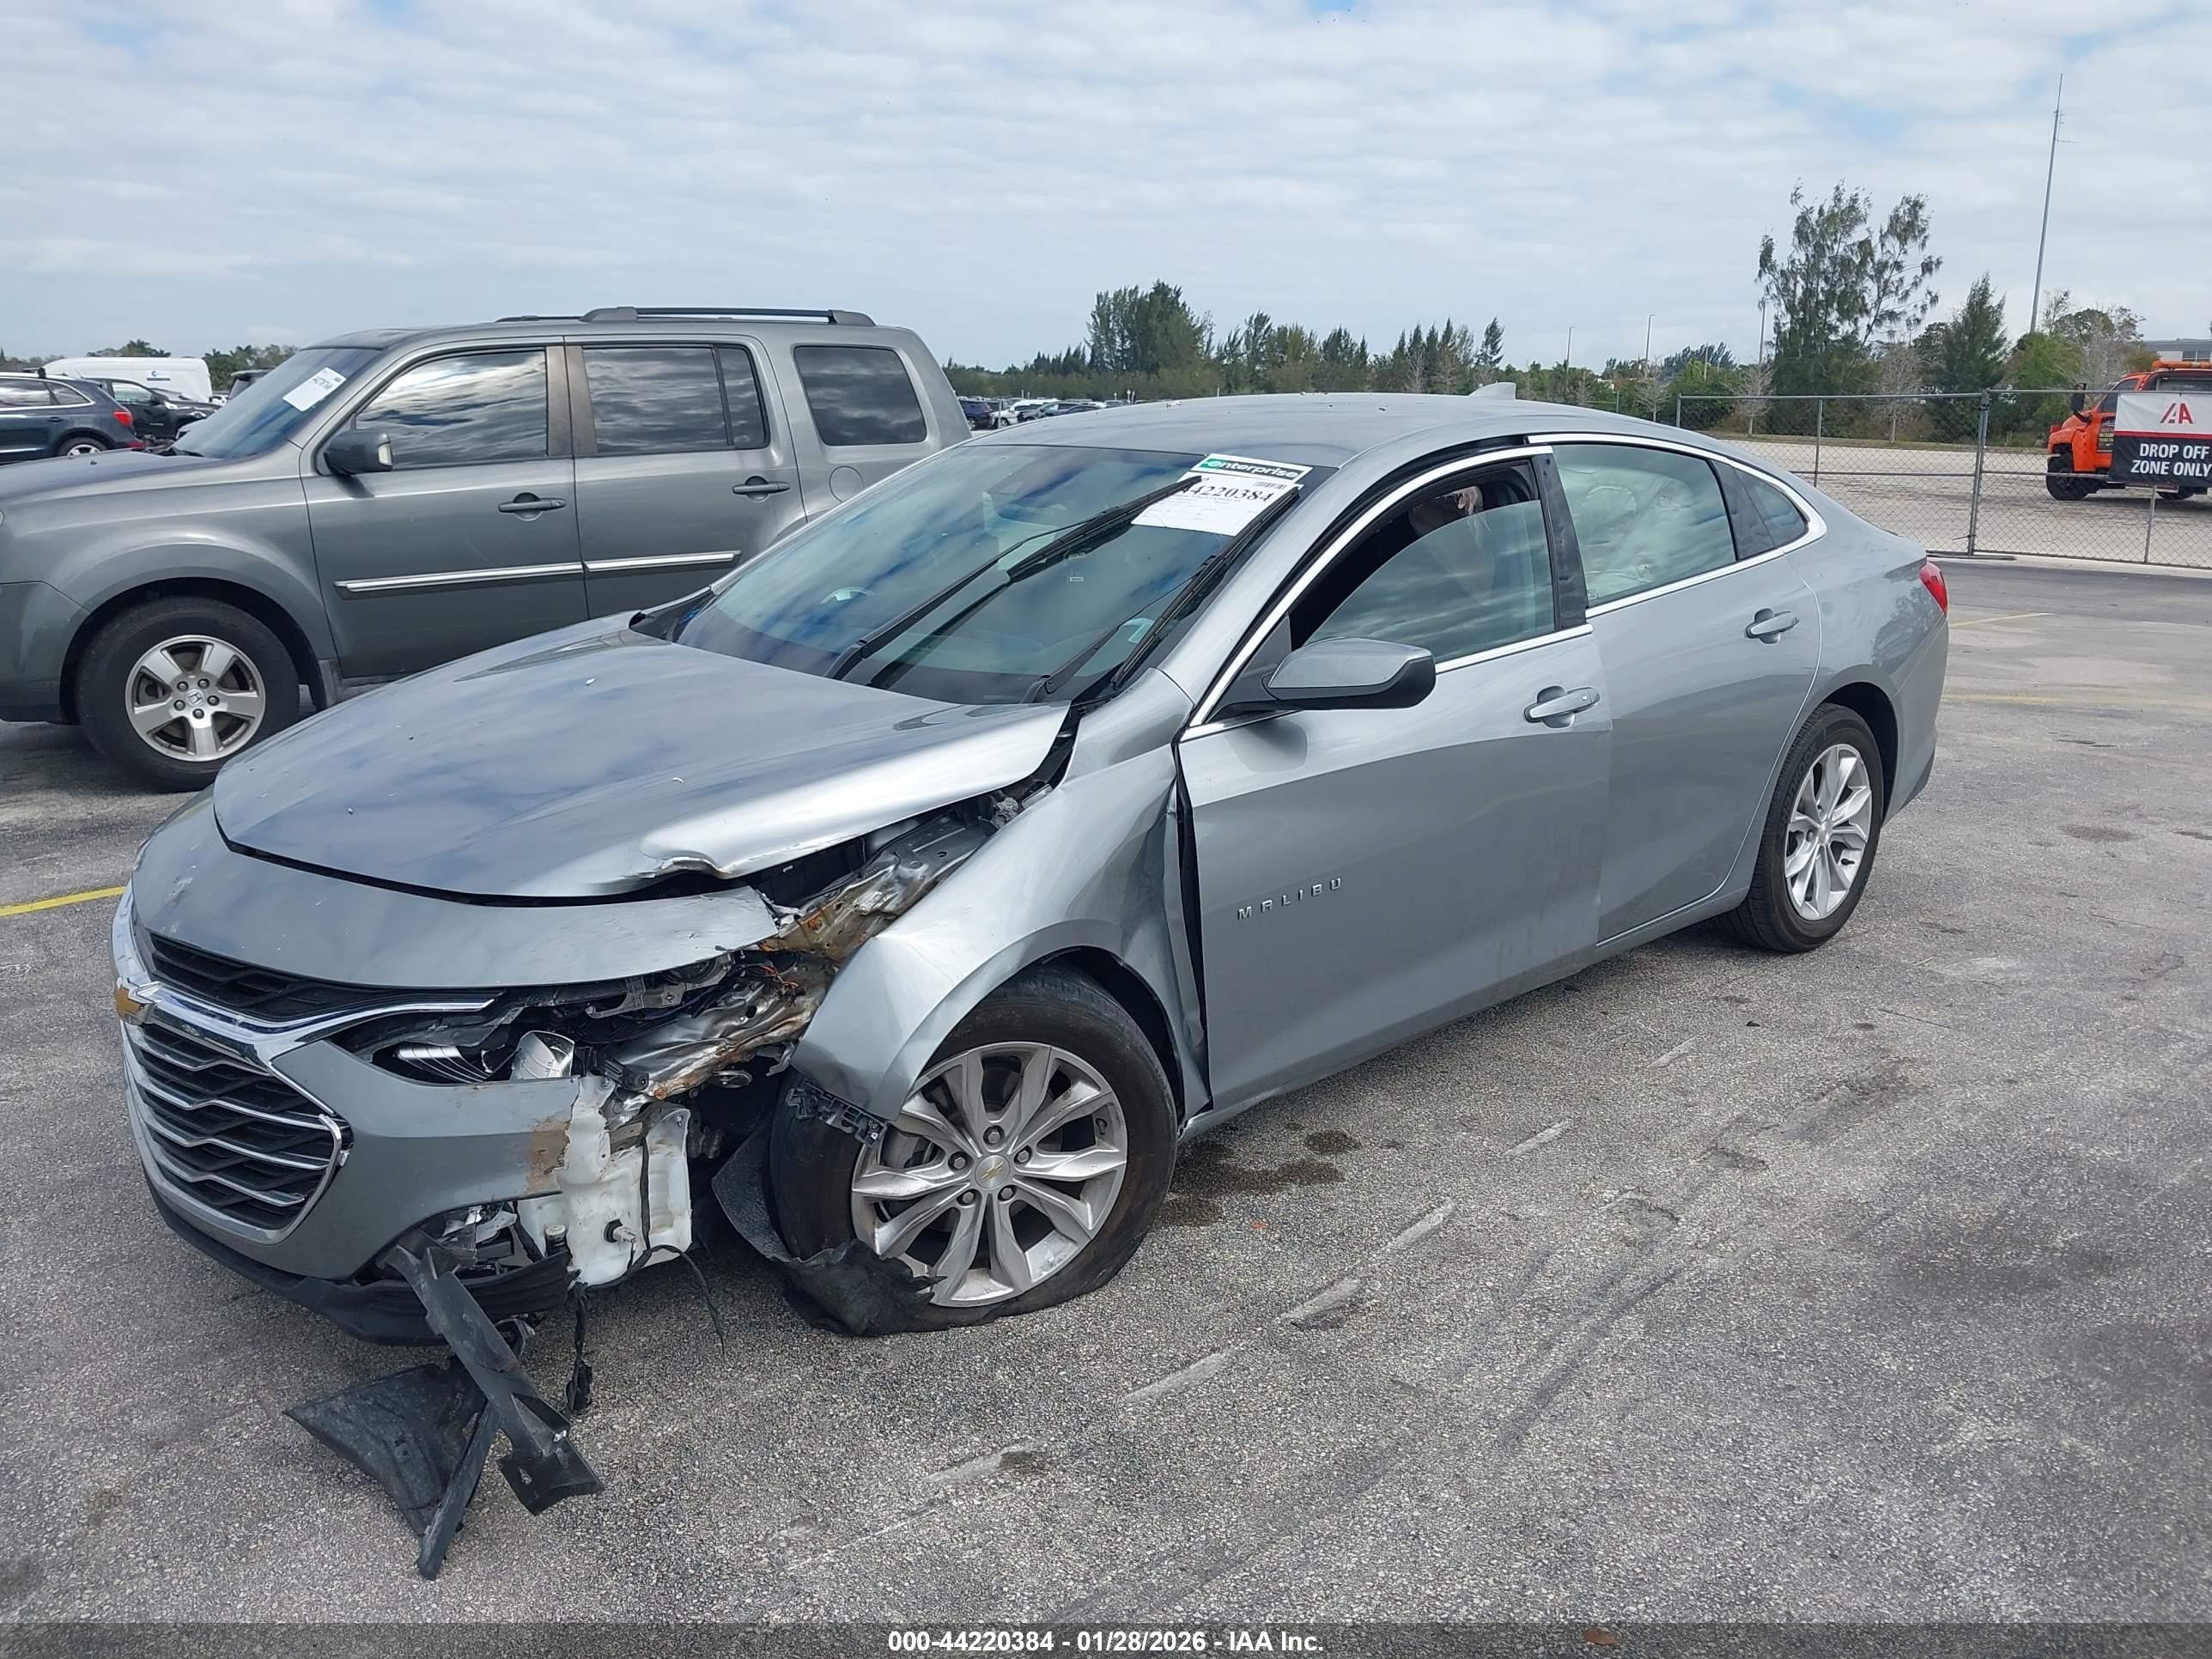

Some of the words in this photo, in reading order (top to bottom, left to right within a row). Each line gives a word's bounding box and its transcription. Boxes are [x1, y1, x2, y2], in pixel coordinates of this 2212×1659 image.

[2140, 443, 2179, 459] DROP
[2183, 445, 2210, 460] OFF
[1206, 459, 1299, 479] enterprise
[2130, 459, 2171, 475] ZONE
[2173, 462, 2212, 477] ONLY
[1237, 878, 1341, 921] MALIBU
